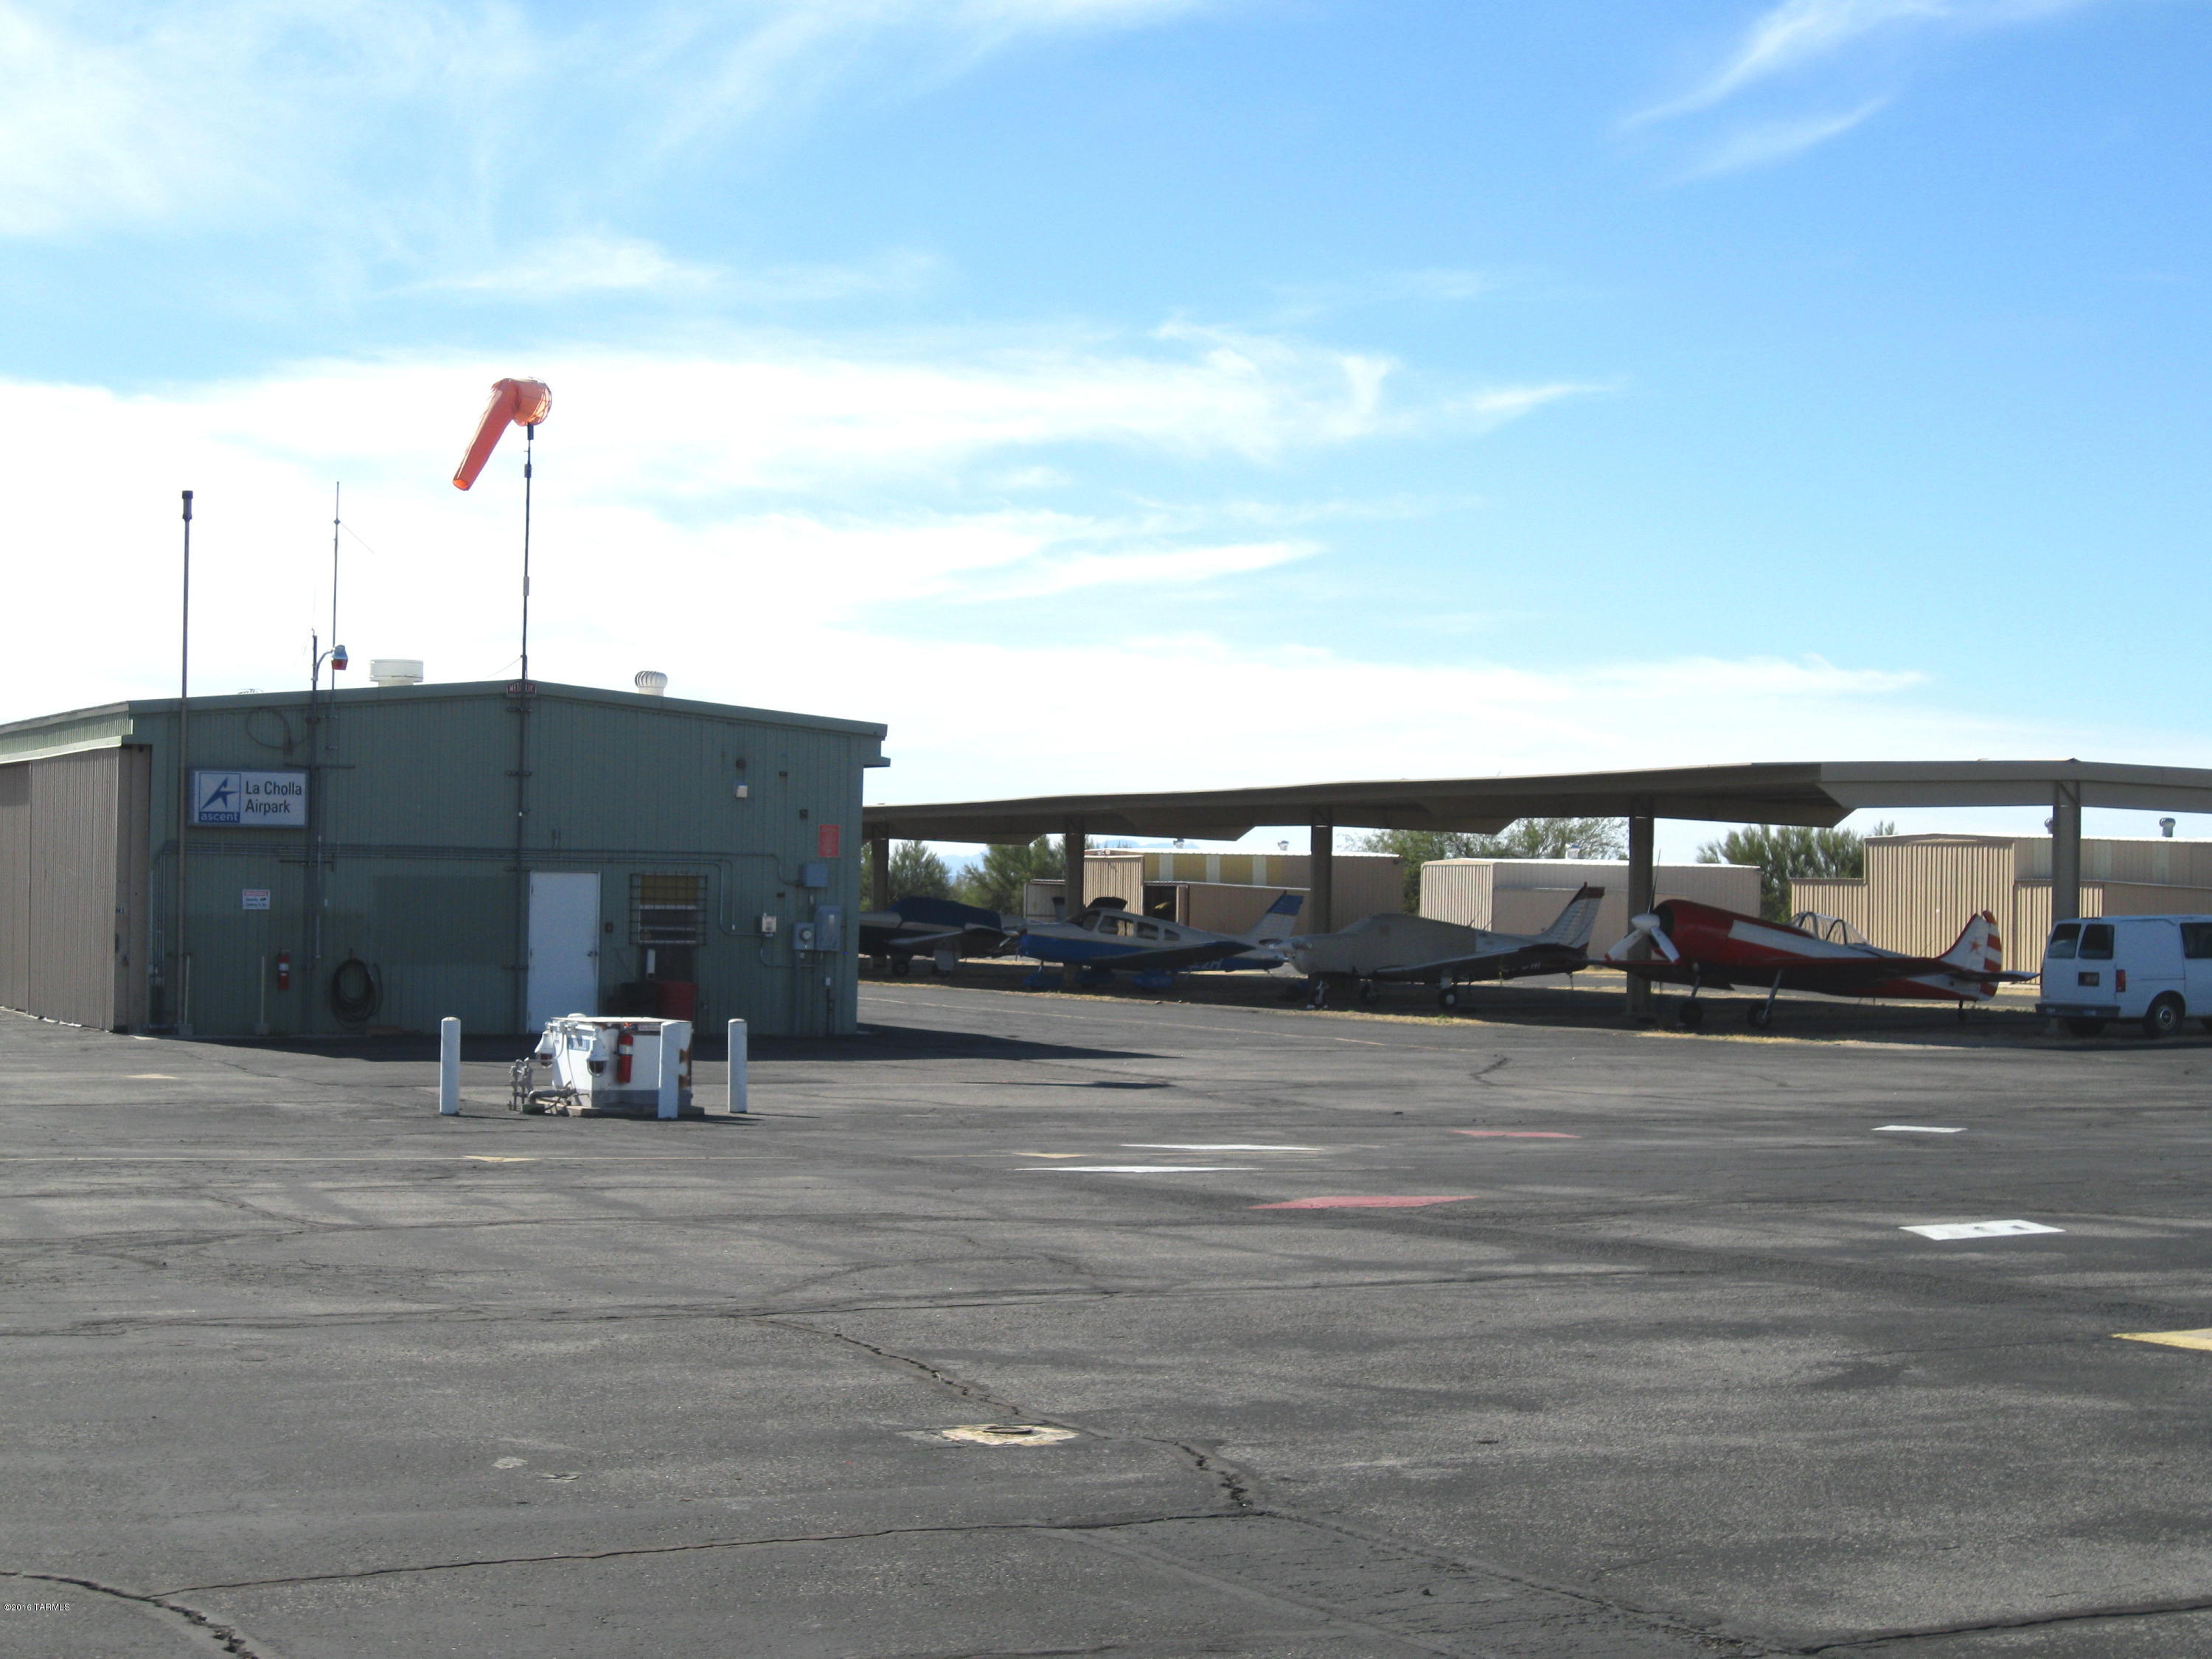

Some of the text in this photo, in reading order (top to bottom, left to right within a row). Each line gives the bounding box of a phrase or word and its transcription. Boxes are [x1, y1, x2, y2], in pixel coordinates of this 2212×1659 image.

[246, 781, 302, 796] La Cholla
[245, 799, 291, 815] Airpark
[201, 813, 239, 822] ascent
